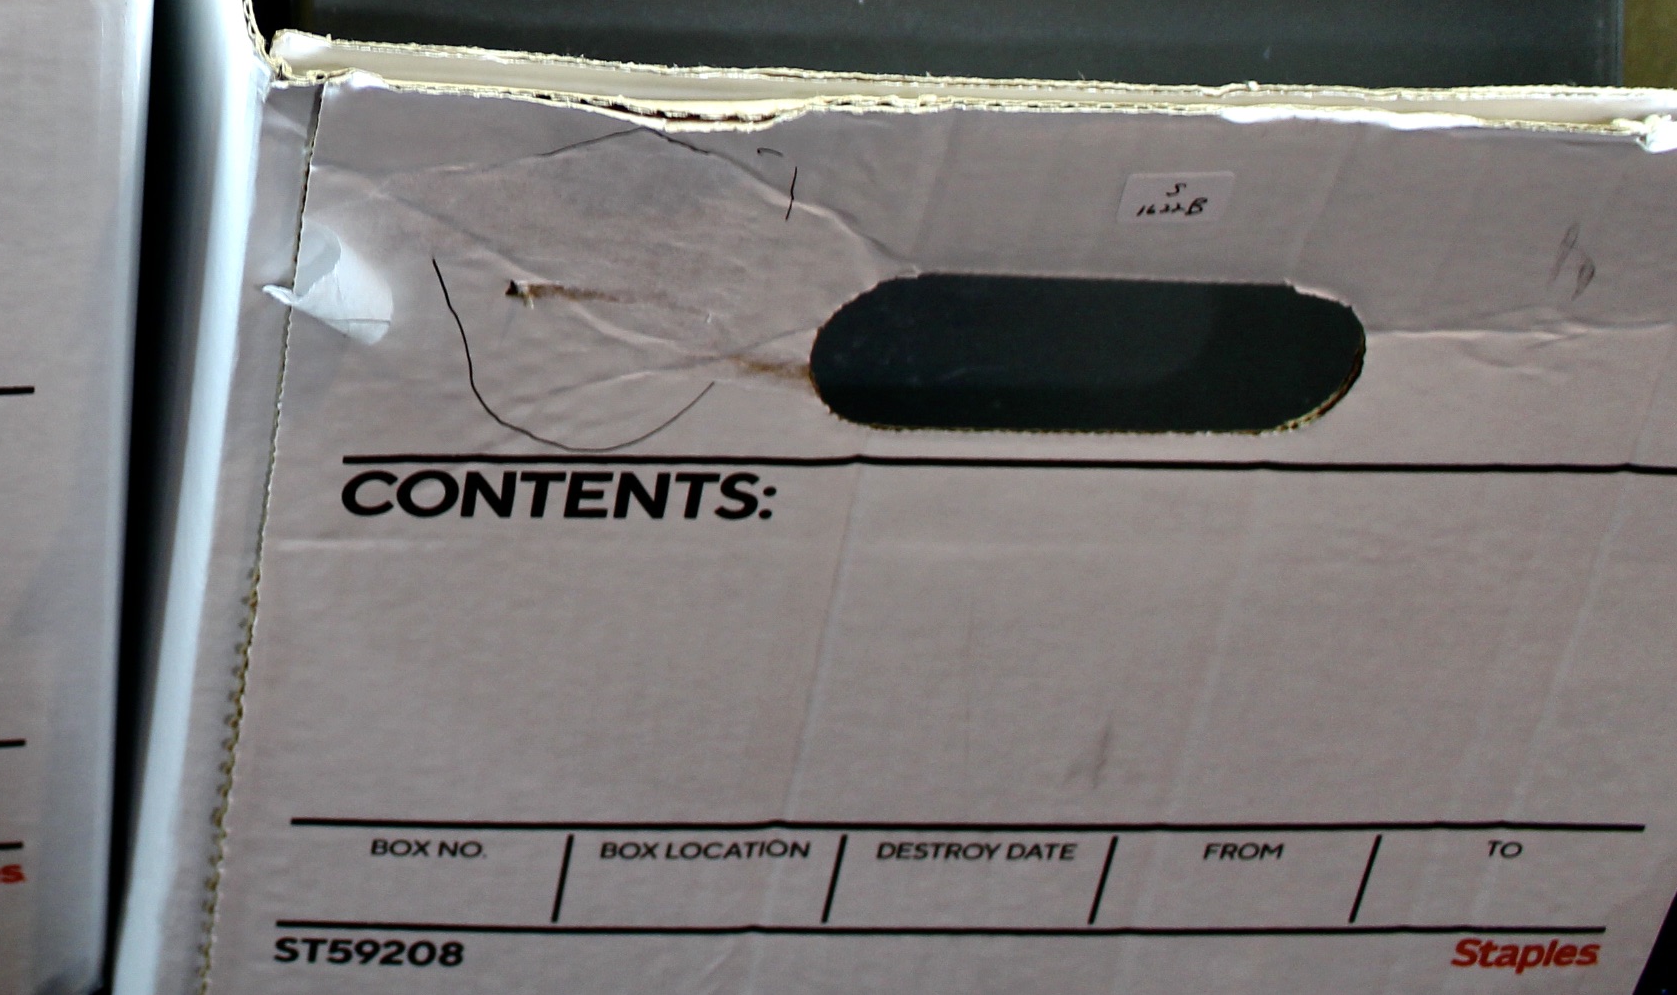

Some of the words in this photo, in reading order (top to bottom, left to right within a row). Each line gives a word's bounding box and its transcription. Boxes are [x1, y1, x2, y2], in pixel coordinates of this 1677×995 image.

[340, 469, 778, 521] CONTENTS:
[369, 838, 431, 858] BOX
[437, 840, 488, 860] NO.
[599, 841, 660, 861] BOX
[664, 838, 812, 861] LOCATION
[875, 841, 1000, 862] DESTROY
[1005, 842, 1078, 862] DATE
[1202, 841, 1285, 862] FROM
[1486, 839, 1524, 860] TO
[273, 936, 465, 968] ST59208
[1450, 937, 1602, 975] Staples
